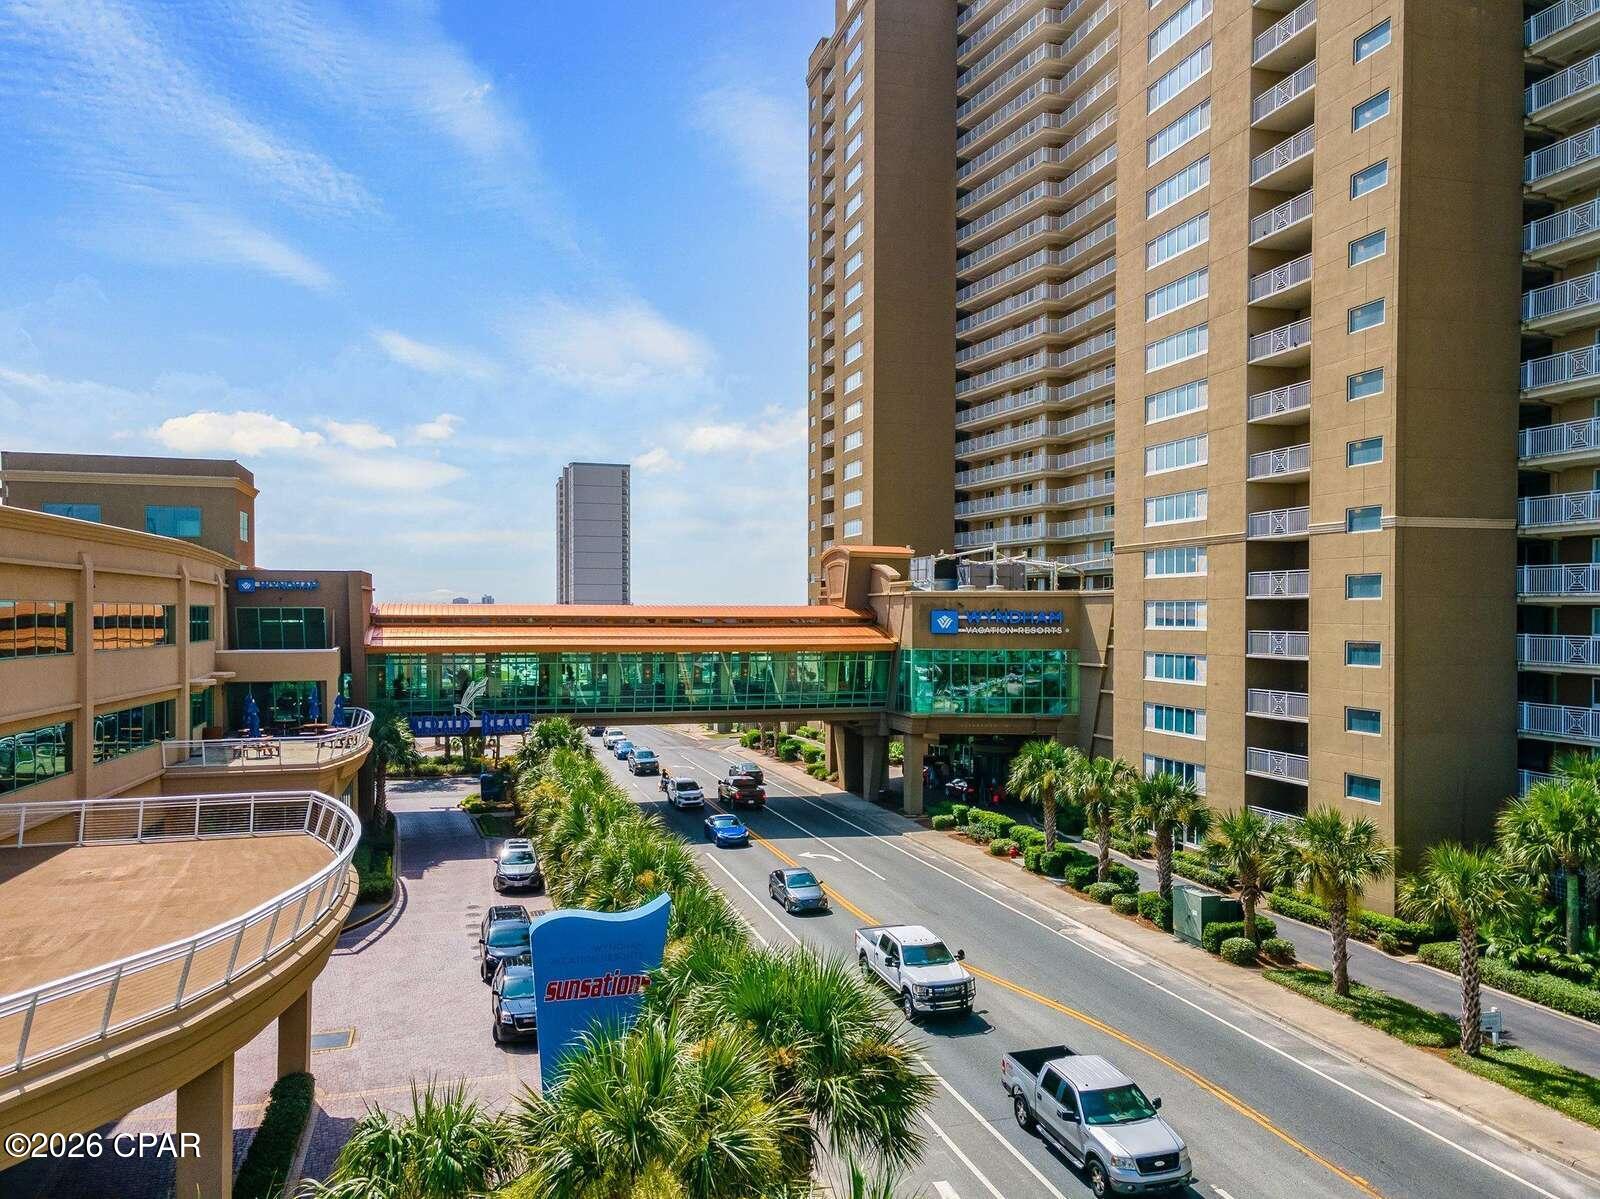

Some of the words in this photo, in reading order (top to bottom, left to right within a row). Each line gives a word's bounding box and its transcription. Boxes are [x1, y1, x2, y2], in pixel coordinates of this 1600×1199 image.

[965, 609, 1063, 624] WYNDHAM
[966, 626, 1014, 634] VACATION
[1018, 626, 1063, 634] RESORTS
